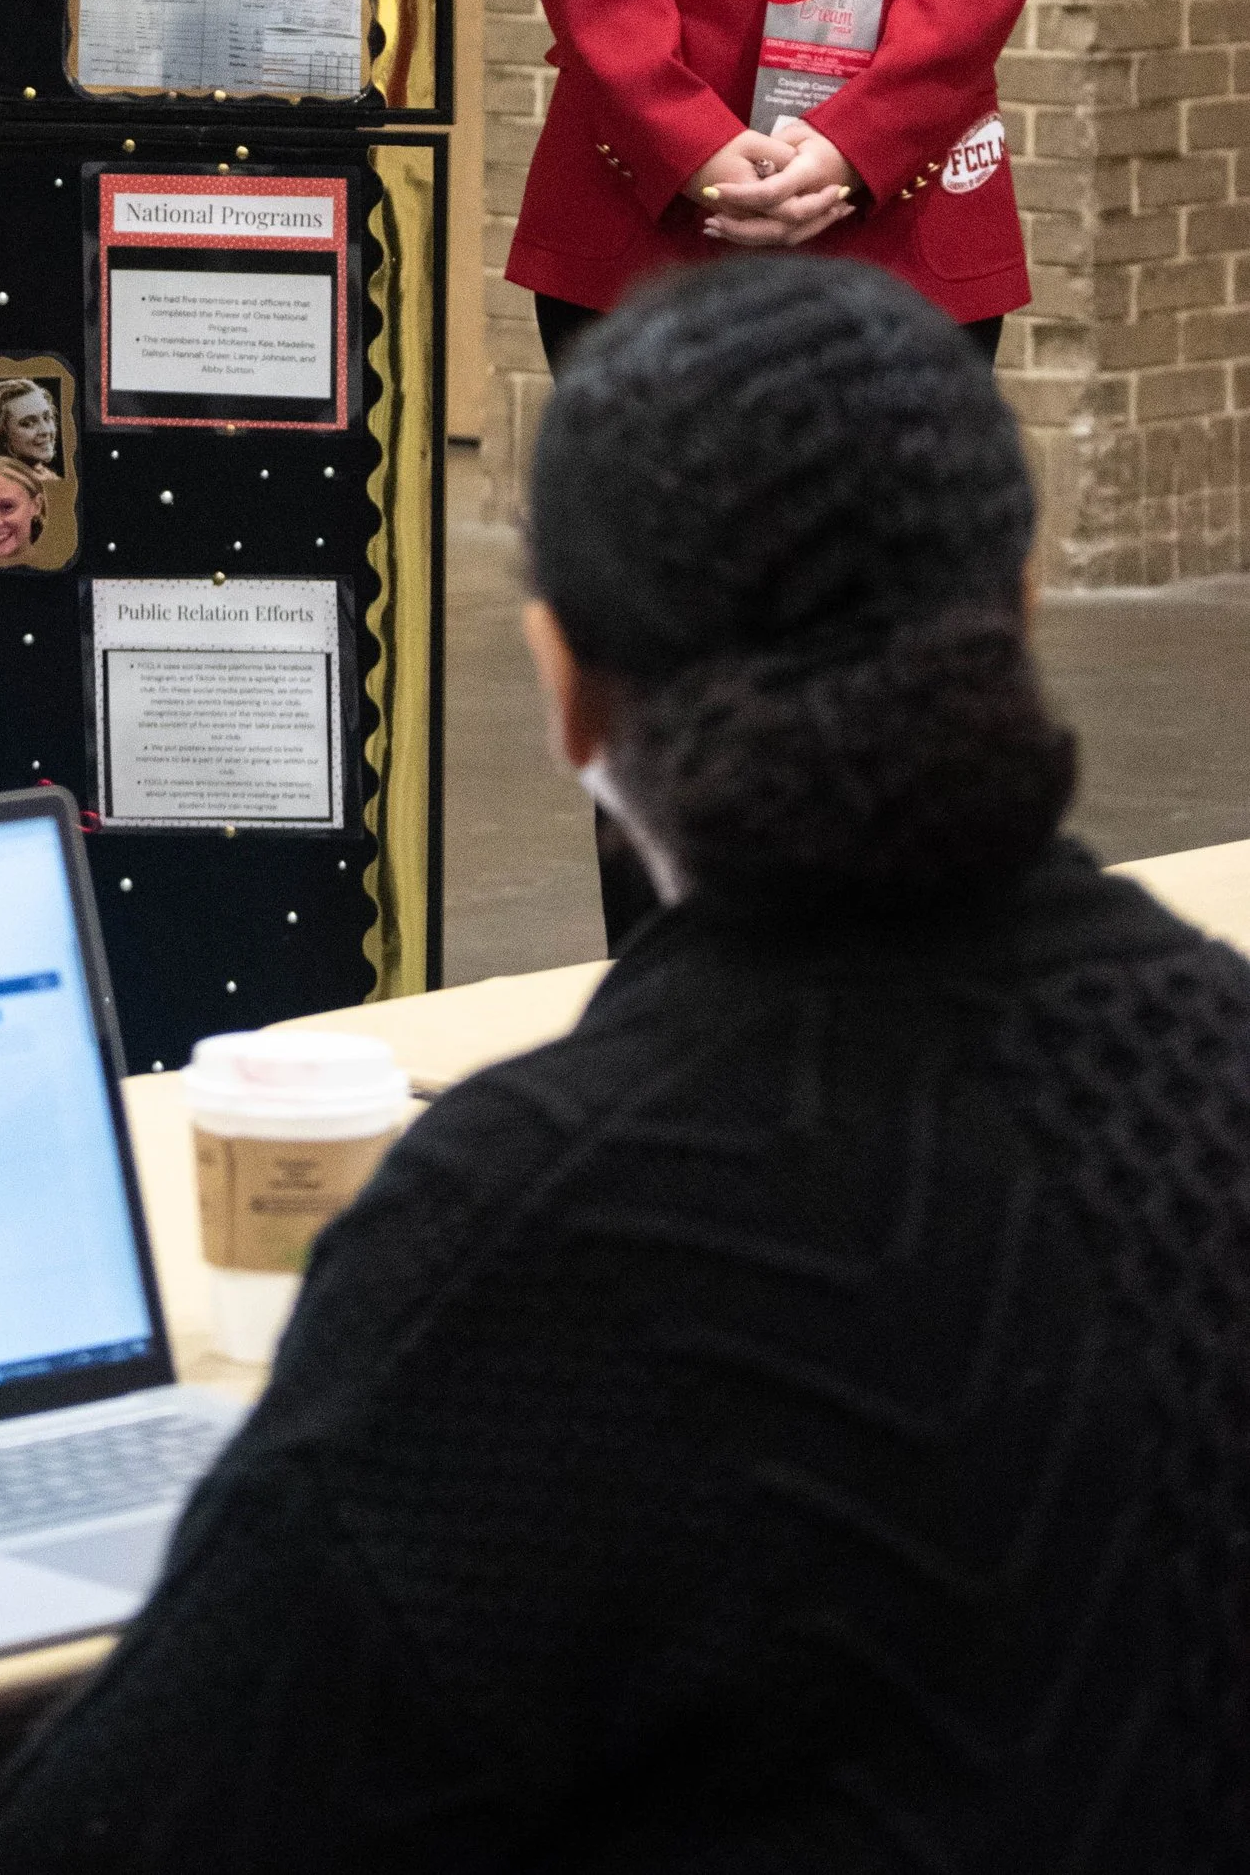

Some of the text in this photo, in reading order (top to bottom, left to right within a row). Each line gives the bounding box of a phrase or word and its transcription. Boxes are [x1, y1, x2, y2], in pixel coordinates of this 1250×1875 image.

[126, 202, 323, 230] National Programs
[117, 603, 314, 623] Public Relation Efforts
